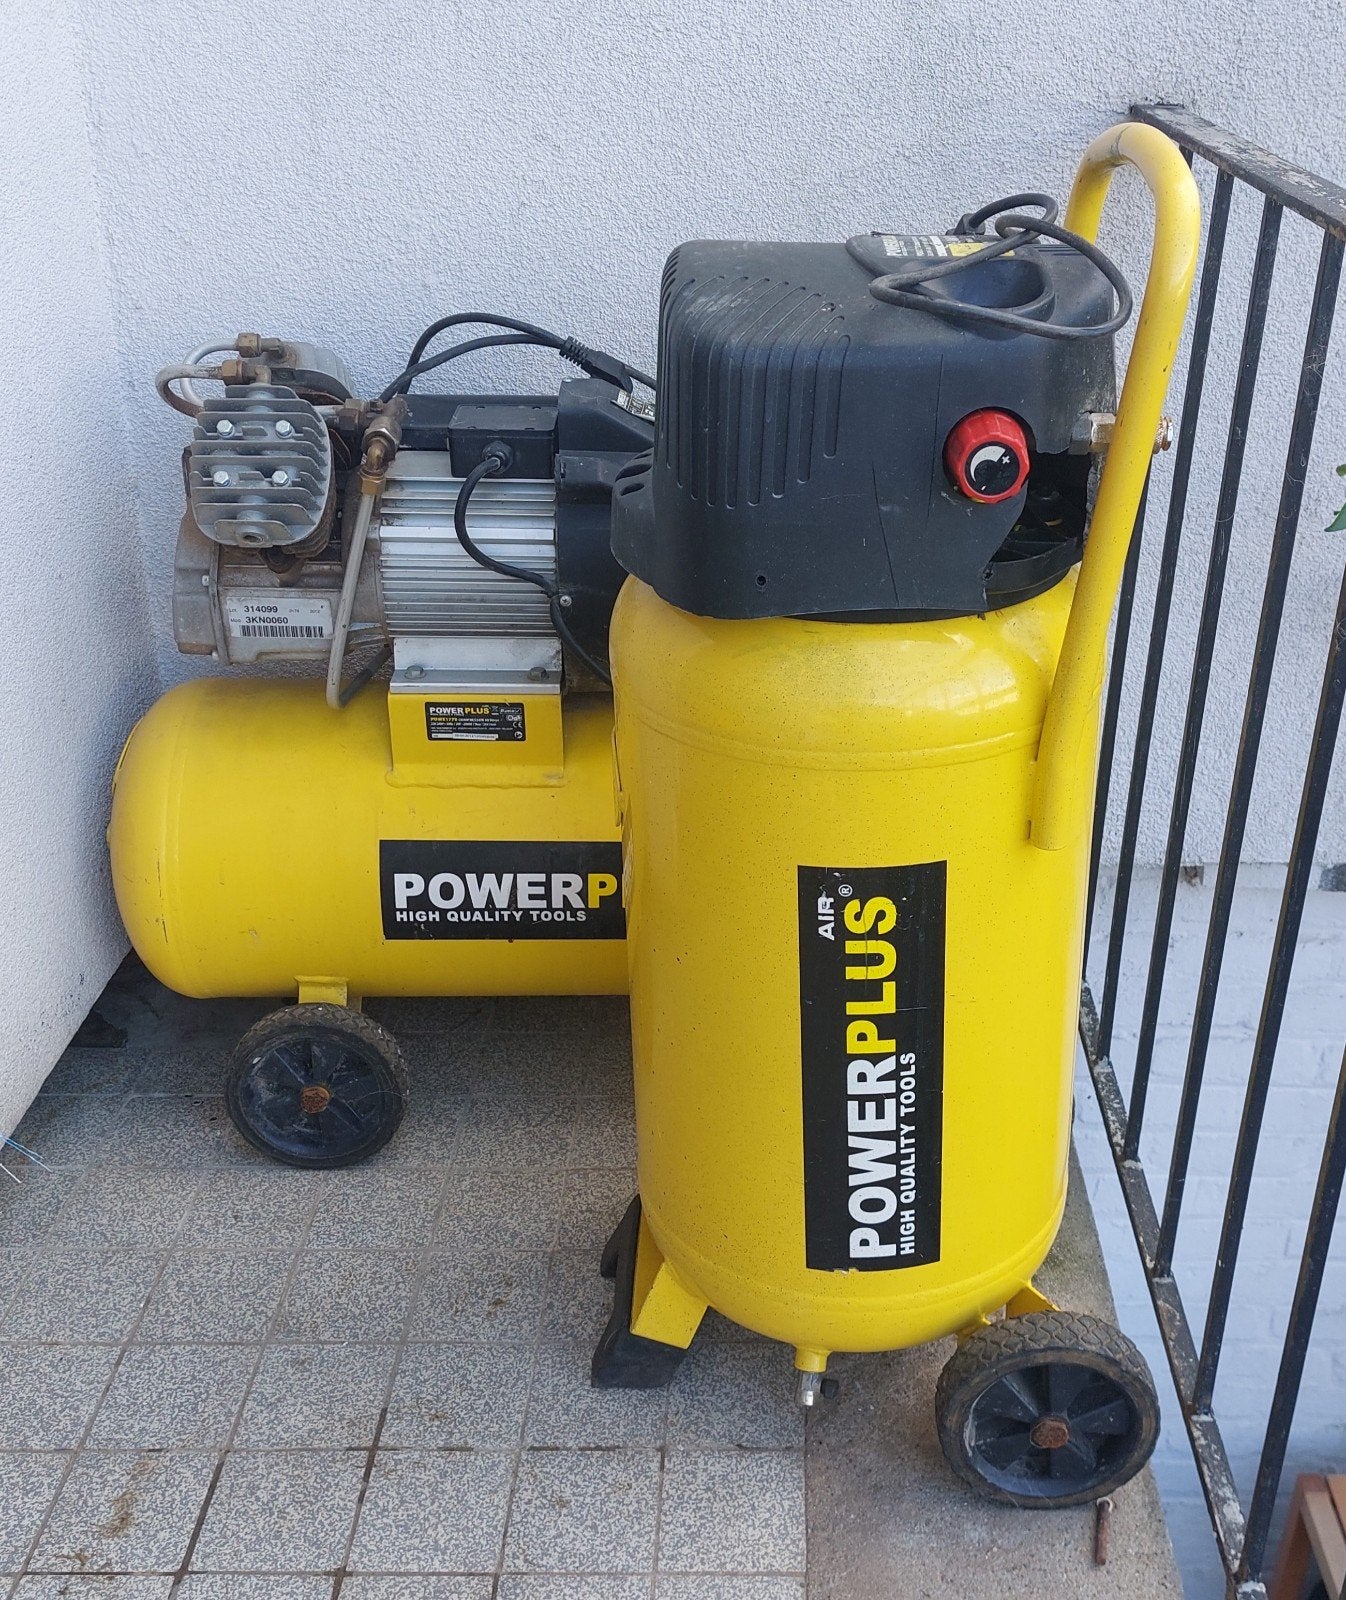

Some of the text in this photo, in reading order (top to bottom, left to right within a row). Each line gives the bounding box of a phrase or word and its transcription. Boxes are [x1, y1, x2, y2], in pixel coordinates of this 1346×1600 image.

[243, 605, 278, 613] 314099
[245, 616, 289, 624] 3KN0060
[393, 872, 625, 909] POWERP
[396, 910, 587, 923] HIGH QUALITY TOOLS
[817, 896, 835, 941] AIR
[900, 1052, 916, 1255] HIGH QUALITY TOOLS
